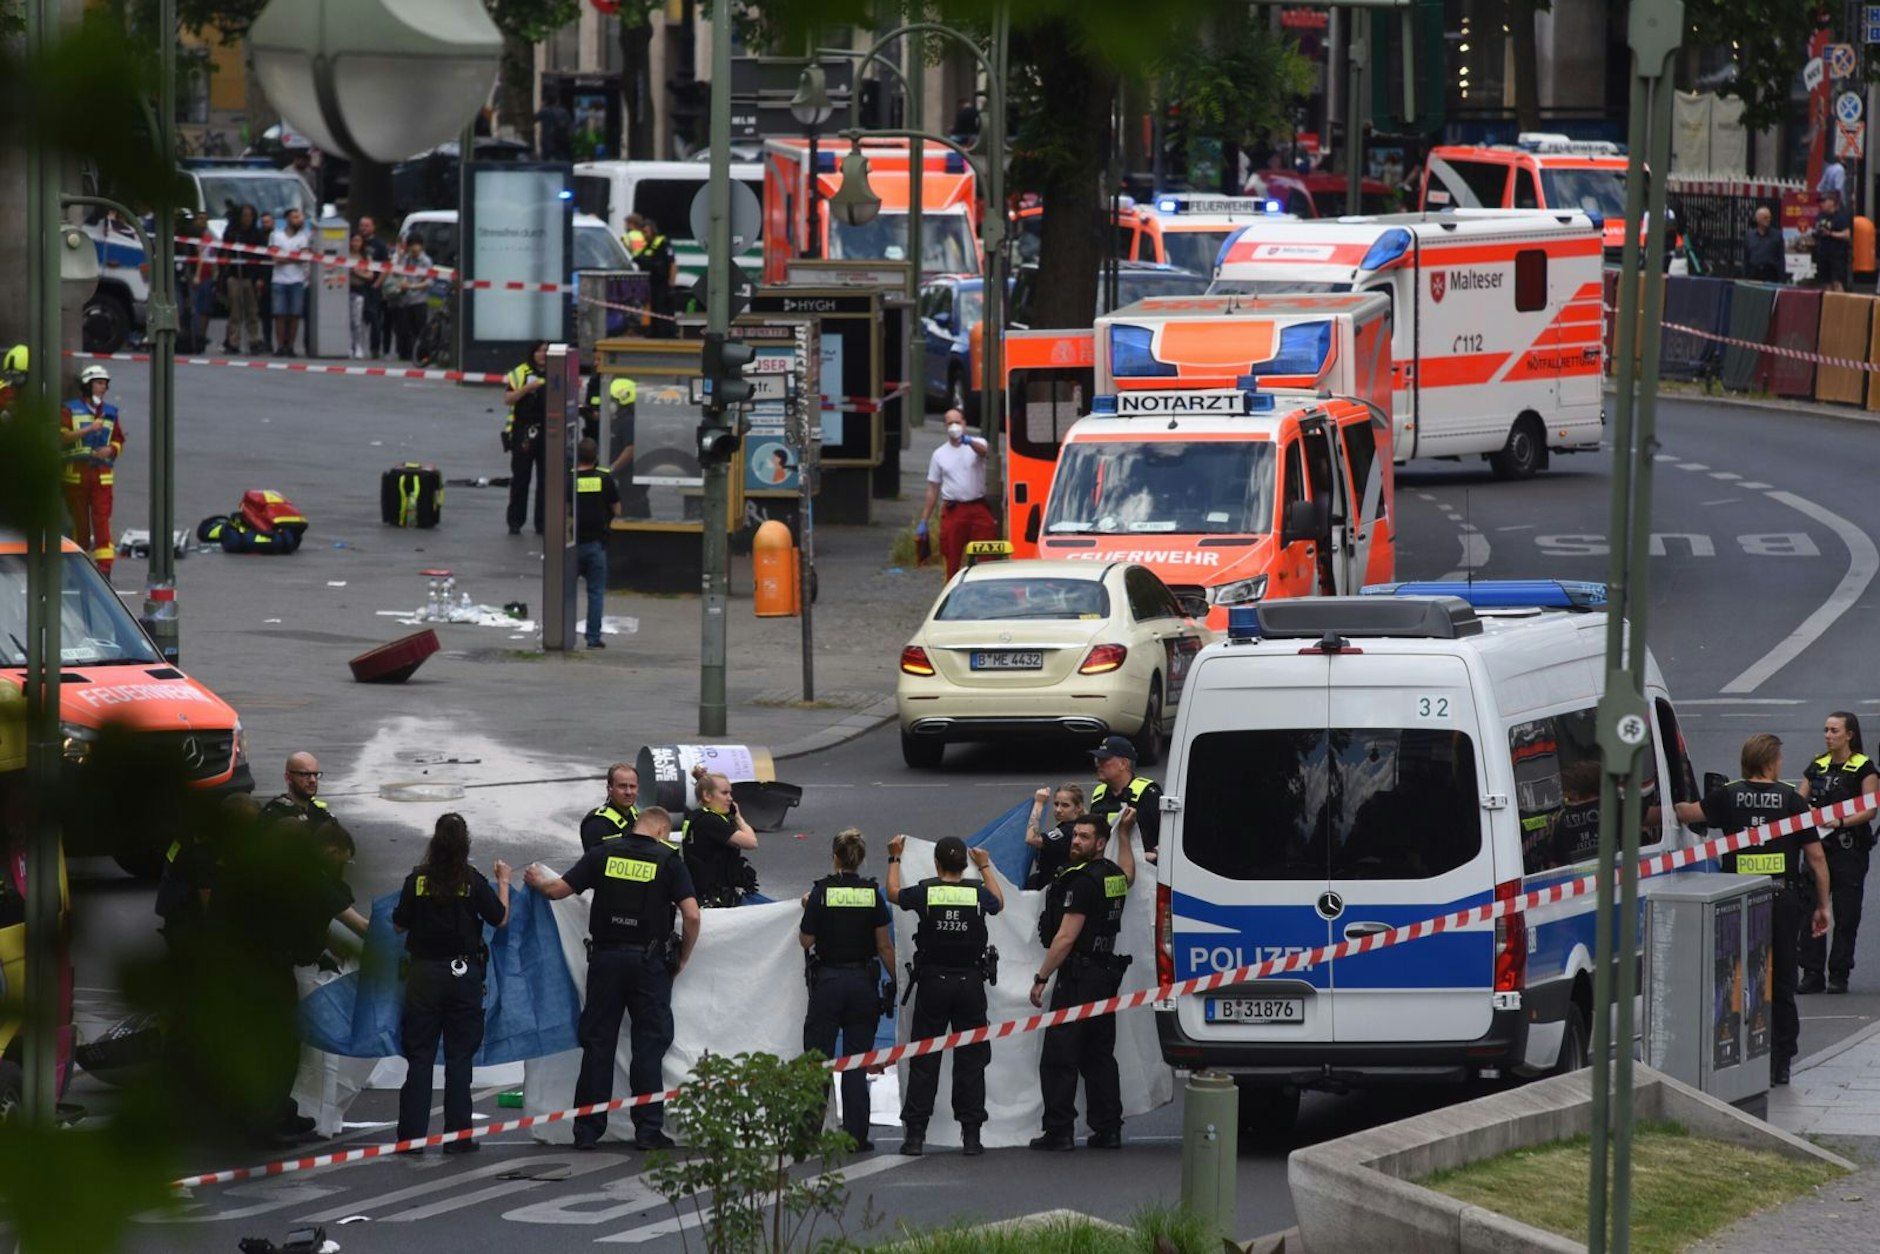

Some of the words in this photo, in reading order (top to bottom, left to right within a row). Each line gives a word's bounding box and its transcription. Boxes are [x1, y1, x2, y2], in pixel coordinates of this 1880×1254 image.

[1192, 200, 1253, 212] FEUERWEHR
[1450, 269, 1503, 291] Malteser
[798, 300, 836, 312] HYGH
[1463, 333, 1483, 352] 112
[1122, 396, 1239, 411] NOTARZT
[973, 542, 1005, 553] TAXI
[1534, 533, 1820, 557] BUS
[978, 652, 986, 666] B
[993, 652, 1009, 666] ME
[1011, 652, 1040, 666] 4432
[77, 683, 212, 707] FEUERWEHR
[1419, 698, 1449, 717] 32
[1736, 791, 1783, 809] POLIZEI
[1751, 816, 1766, 826] BE
[608, 859, 657, 880] POLIZEI
[1739, 857, 1783, 872] POLIZEI
[827, 888, 874, 905] POLIZEI
[929, 887, 976, 903] POLIZEI
[611, 915, 638, 927] POLIZEI
[945, 910, 960, 920] BE
[936, 920, 968, 932] 32326
[1223, 1002, 1233, 1017] B
[1244, 1002, 1293, 1018] 31876
